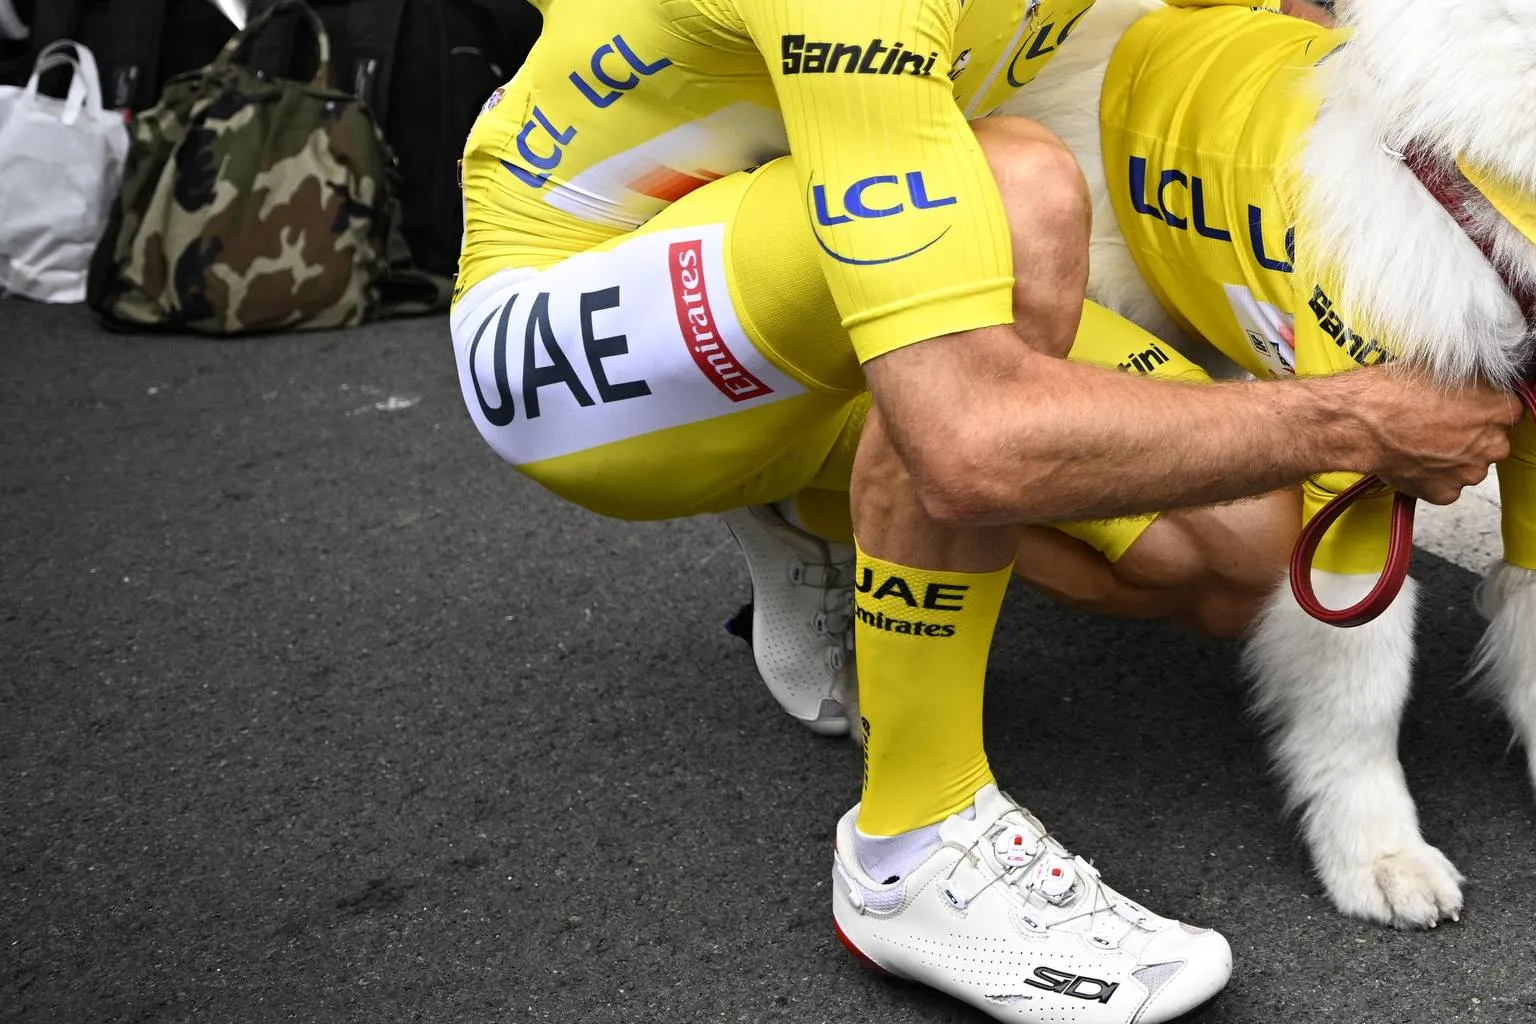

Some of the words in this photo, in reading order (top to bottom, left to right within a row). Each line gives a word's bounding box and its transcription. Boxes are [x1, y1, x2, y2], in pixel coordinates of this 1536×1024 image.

[569, 34, 674, 109] LCL
[781, 33, 938, 77] Santini
[500, 107, 577, 189] LCL
[812, 170, 958, 226] LCL
[1129, 155, 1232, 242] LCL
[469, 285, 653, 427] UAE
[678, 248, 759, 397] Emirates
[855, 605, 956, 637] mirates
